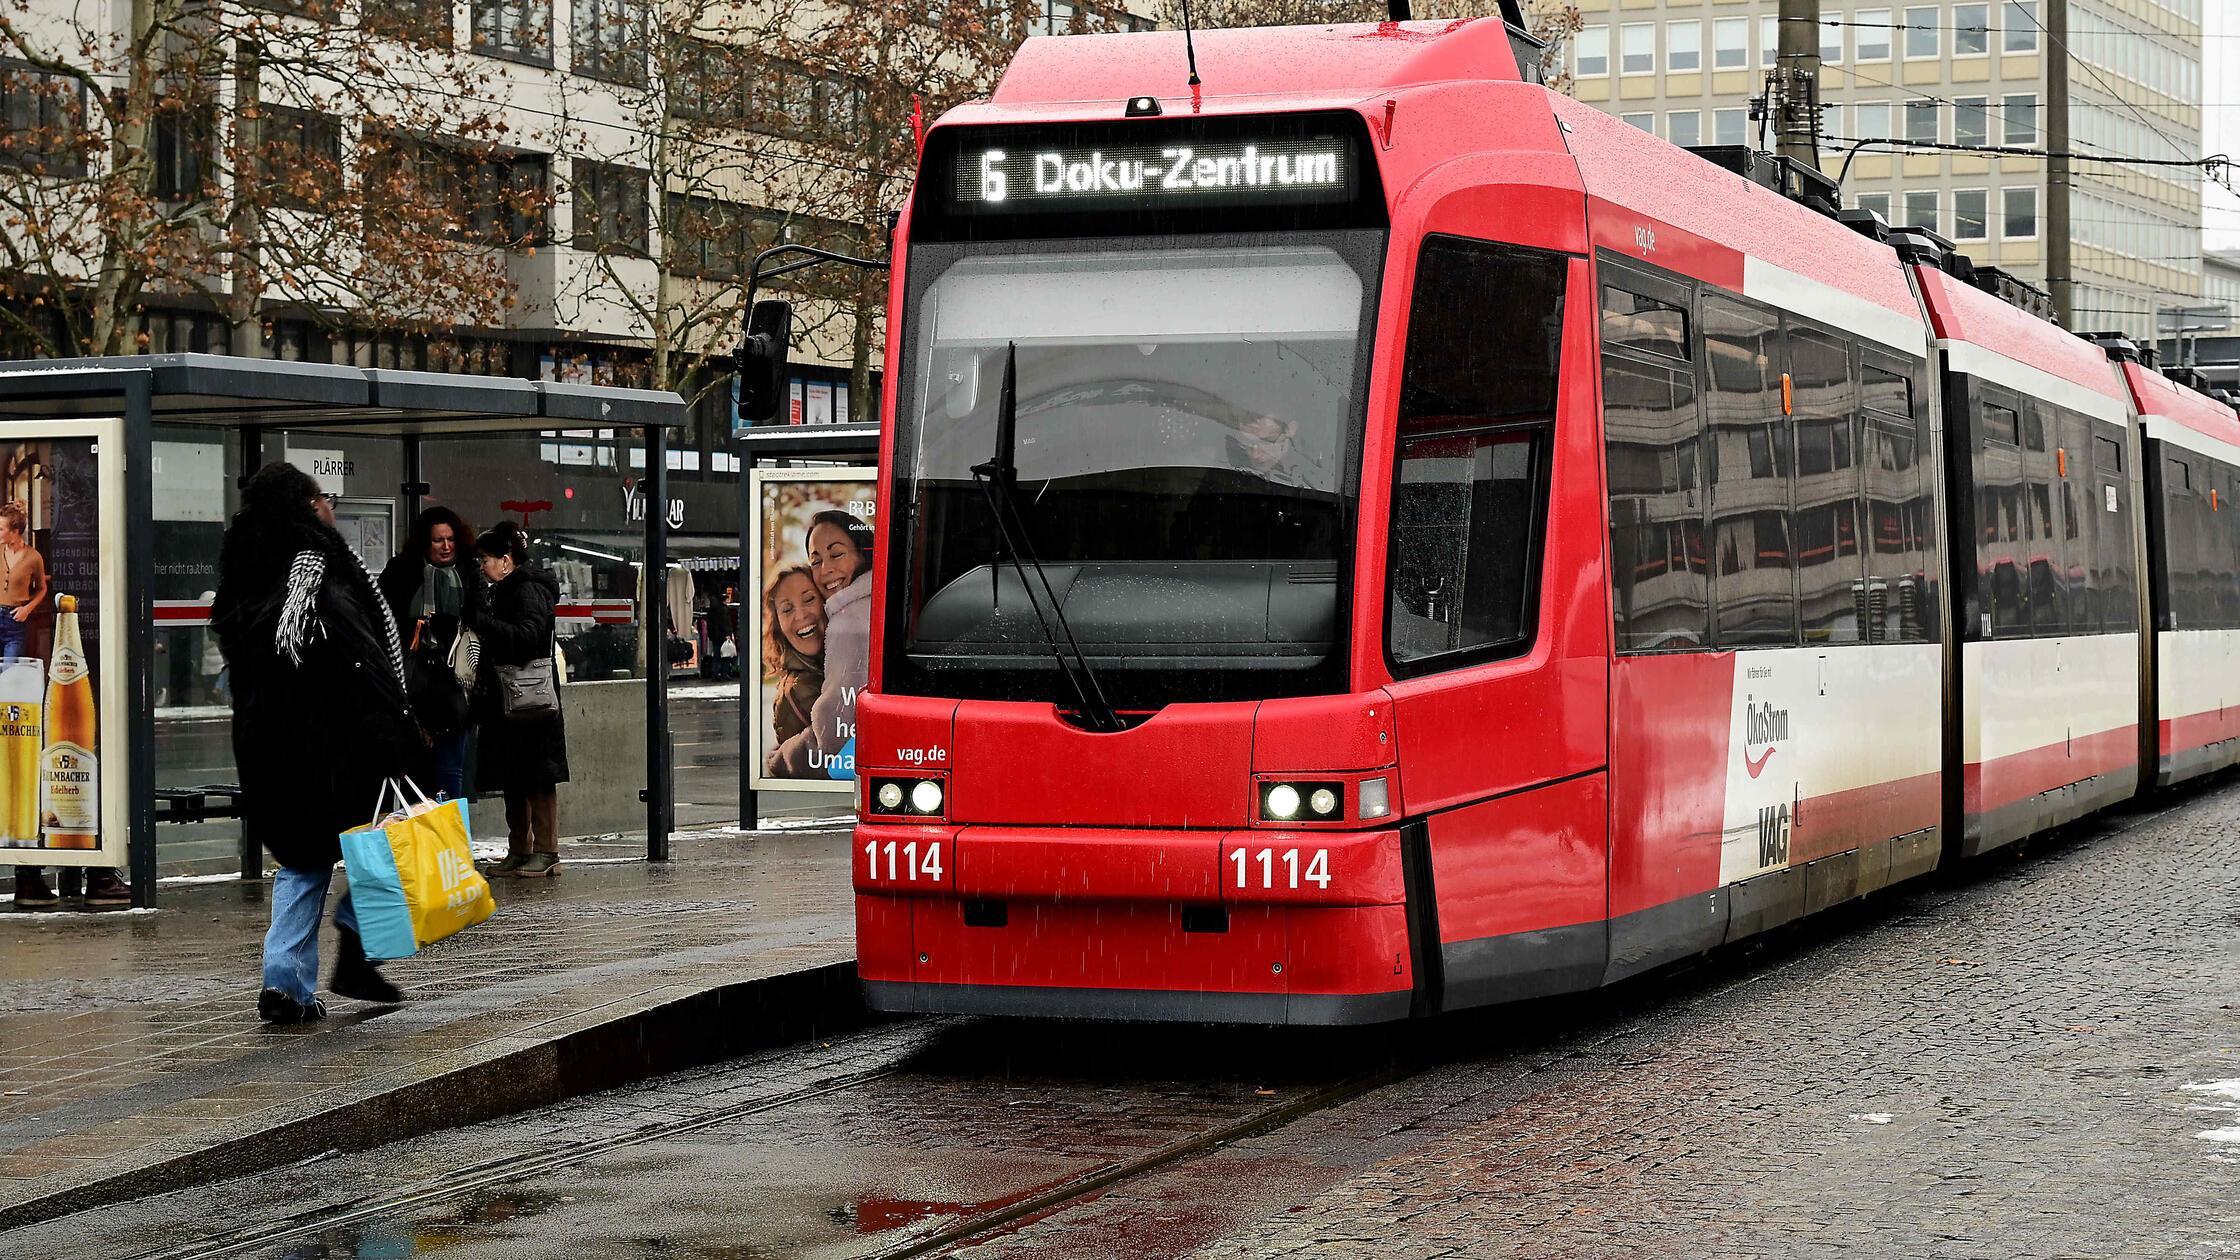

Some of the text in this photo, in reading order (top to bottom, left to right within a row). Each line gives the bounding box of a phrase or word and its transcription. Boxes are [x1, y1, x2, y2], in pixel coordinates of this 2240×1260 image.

[981, 146, 1336, 202] 6 Doku-Zentrum
[1634, 223, 1656, 256] vag.de
[313, 456, 355, 477] PLÄRRER
[1746, 694, 1788, 746] ÖkoStrom
[897, 746, 946, 766] vag.de
[1758, 803, 1788, 869] VAG
[865, 841, 944, 882] 1114
[1229, 848, 1332, 889] 1114
